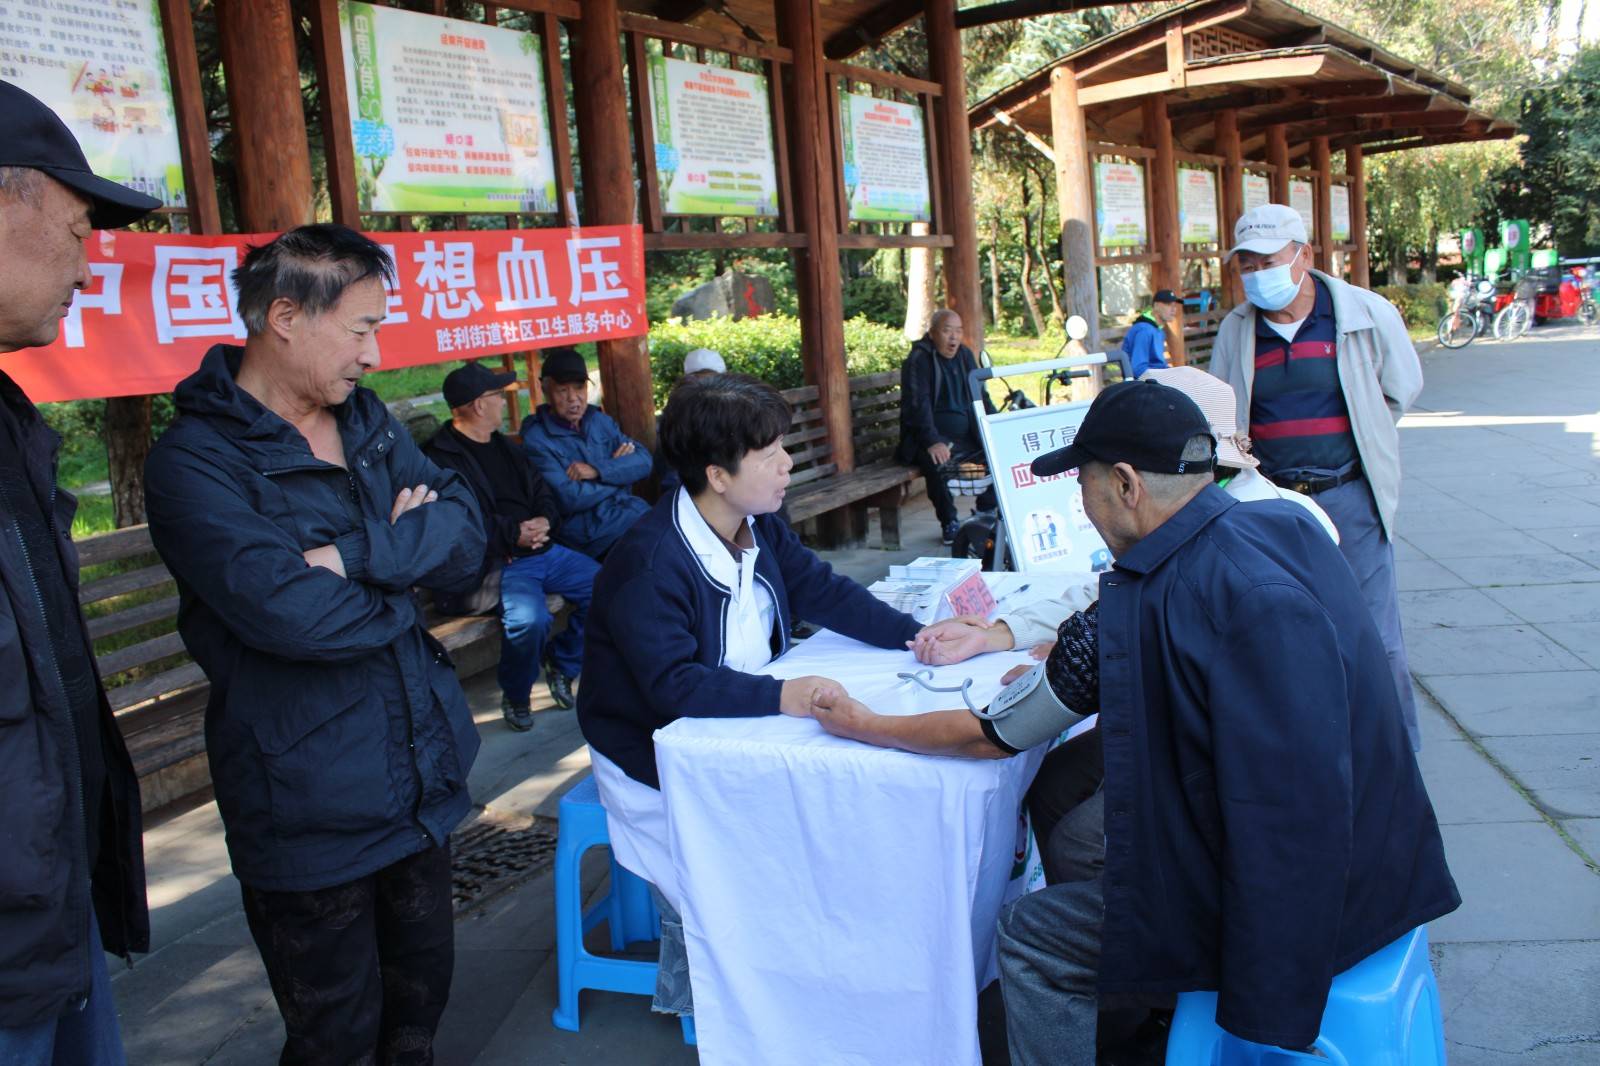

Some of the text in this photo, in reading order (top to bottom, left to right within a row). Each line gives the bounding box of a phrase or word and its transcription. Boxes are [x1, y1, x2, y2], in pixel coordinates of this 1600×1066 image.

[381, 236, 631, 327] 想血压
[436, 312, 633, 353] 胜利街道社区卫生服务中心
